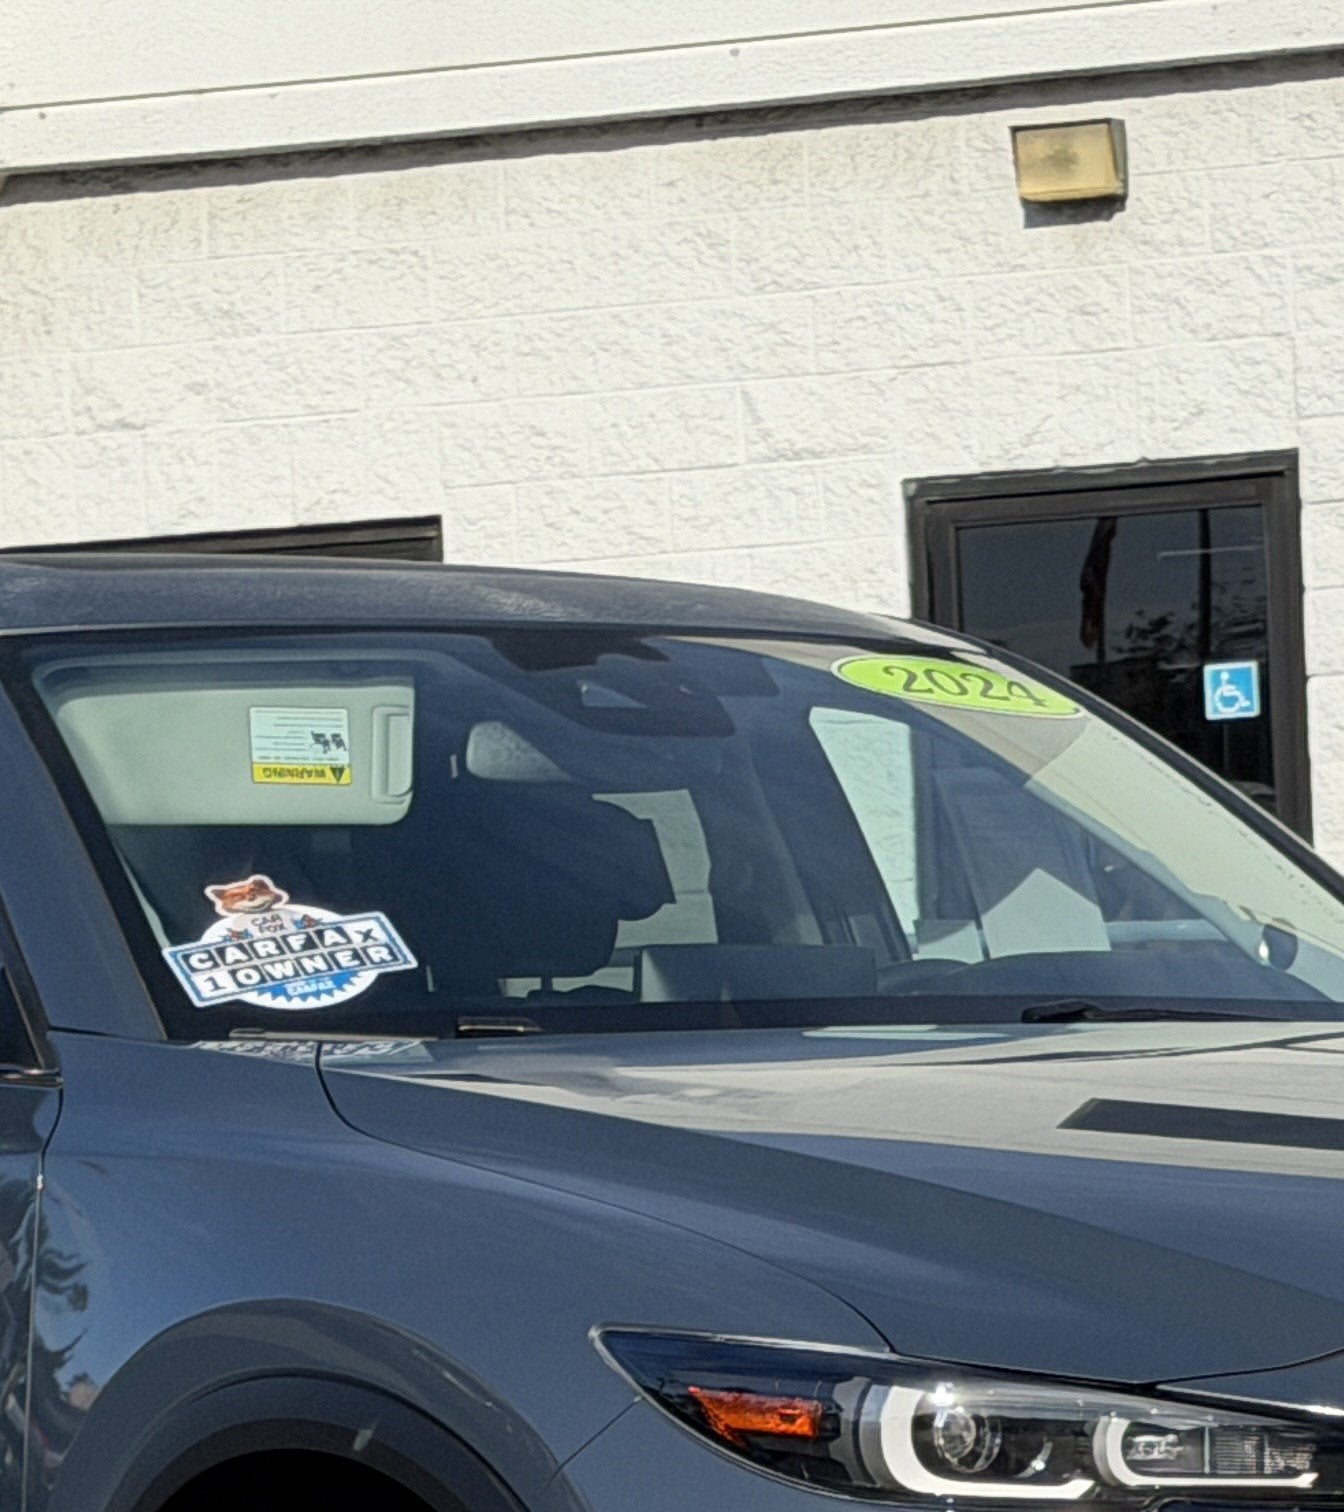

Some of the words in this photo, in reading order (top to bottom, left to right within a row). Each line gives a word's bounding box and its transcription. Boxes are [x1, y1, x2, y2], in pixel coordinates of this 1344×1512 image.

[882, 665, 1047, 707] 2024
[187, 928, 383, 971] CARFAX
[202, 973, 227, 992] 1
[235, 945, 394, 985] OWNER
